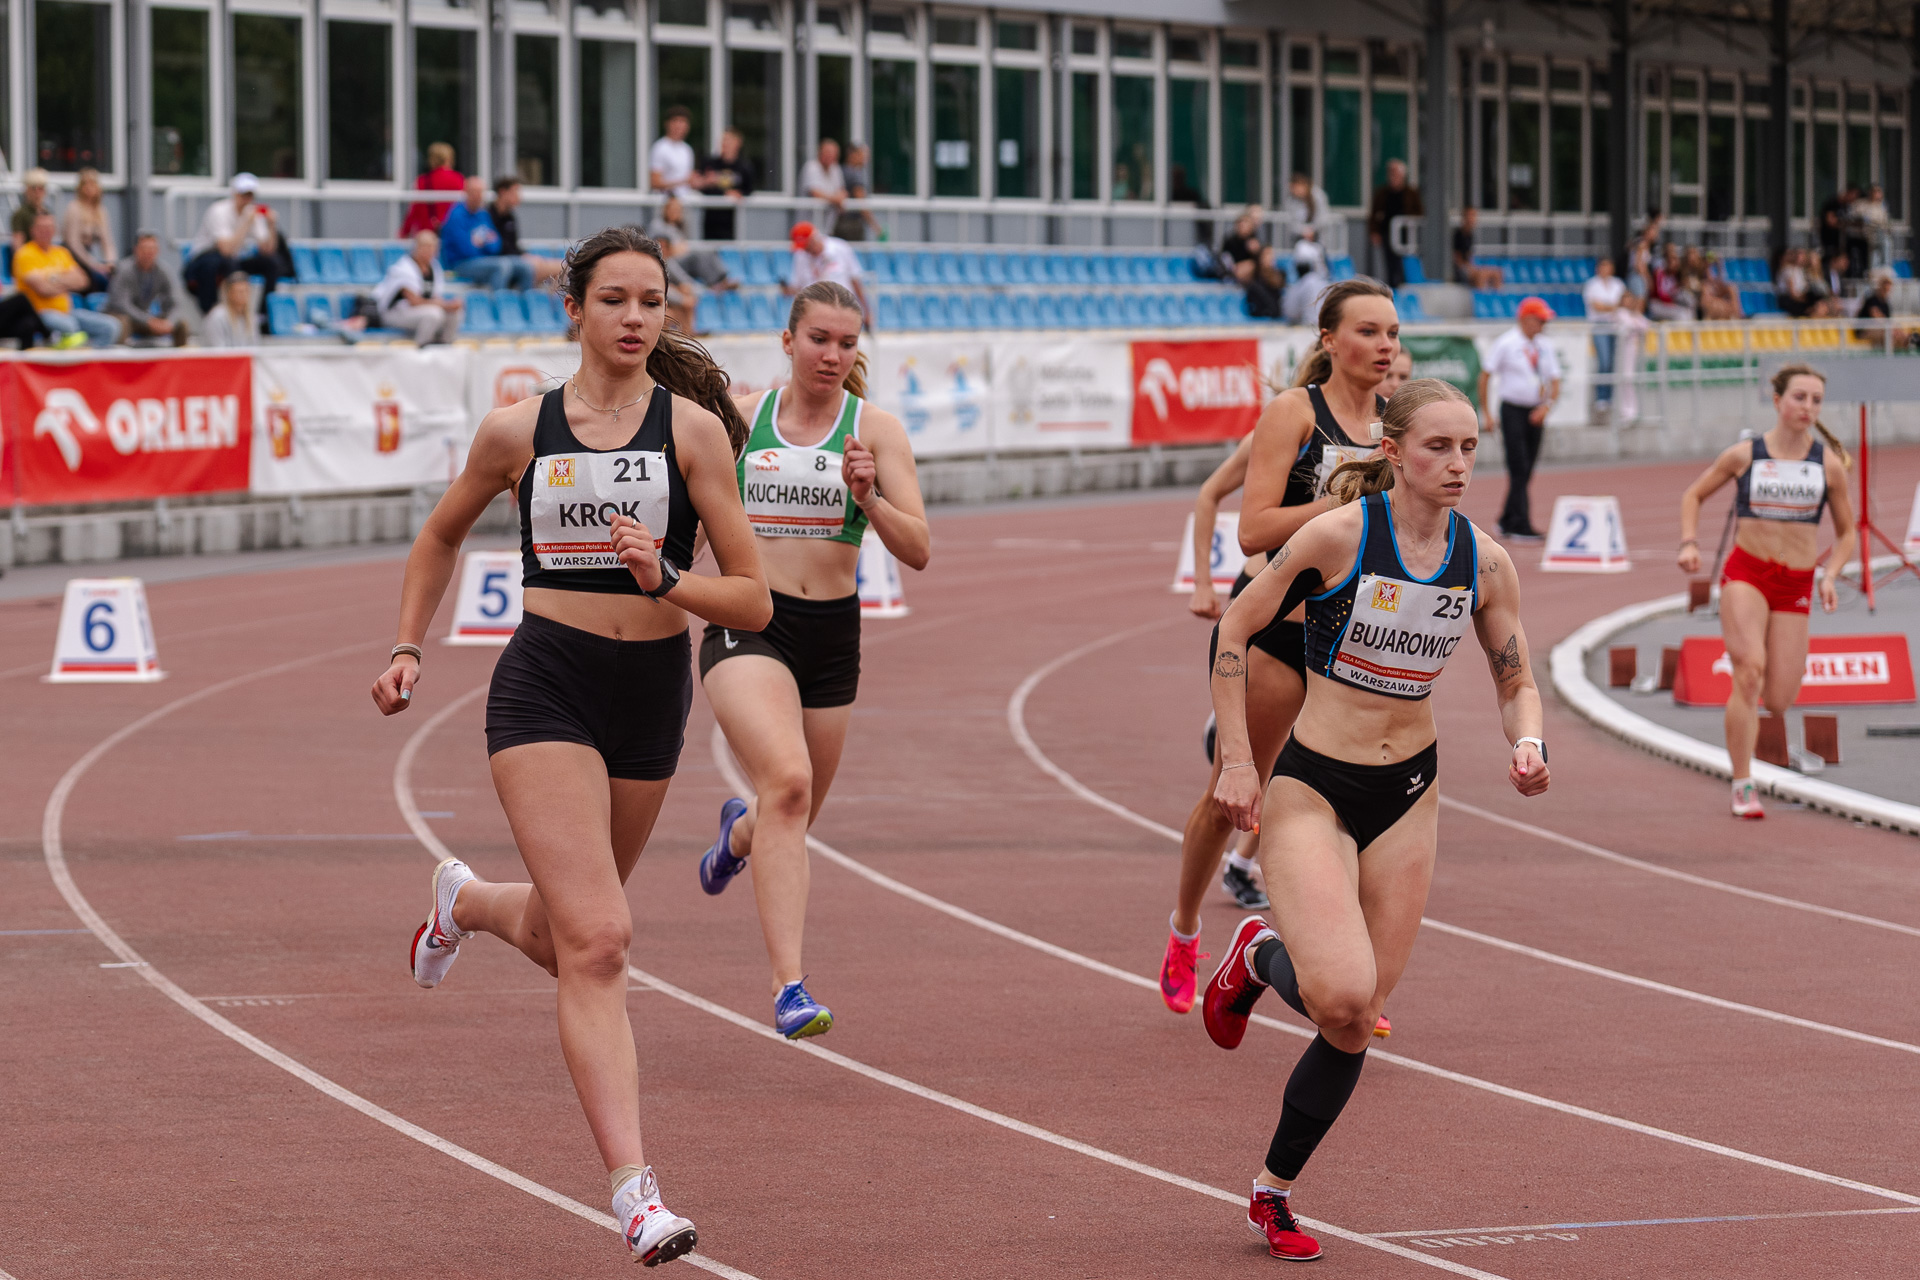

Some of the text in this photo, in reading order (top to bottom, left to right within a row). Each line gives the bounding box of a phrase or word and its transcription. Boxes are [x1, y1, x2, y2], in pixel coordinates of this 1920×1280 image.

[1179, 365, 1257, 412] ORLEN
[104, 393, 239, 457] ORLEN
[613, 457, 650, 483] 21
[814, 455, 827, 471] 8
[1800, 465, 1809, 477] 4
[549, 477, 574, 486] PZLA
[1756, 482, 1817, 498] NOWAK
[747, 482, 843, 507] KUCHARSKA
[559, 500, 642, 528] KROK
[753, 525, 832, 536] WARSZAWA 2025
[1565, 511, 1588, 549] 2
[480, 572, 508, 618] 5
[1371, 600, 1397, 612] PZLA
[1432, 594, 1467, 620] 25
[83, 601, 116, 653] 6
[1340, 654, 1354, 663] PZLA
[1354, 659, 1387, 674] Mistrzostwa
[1386, 669, 1401, 677] Polski
[1804, 659, 1880, 678] RLEN
[1350, 669, 1415, 693] WARSZAWA
[1406, 780, 1425, 795] erima
